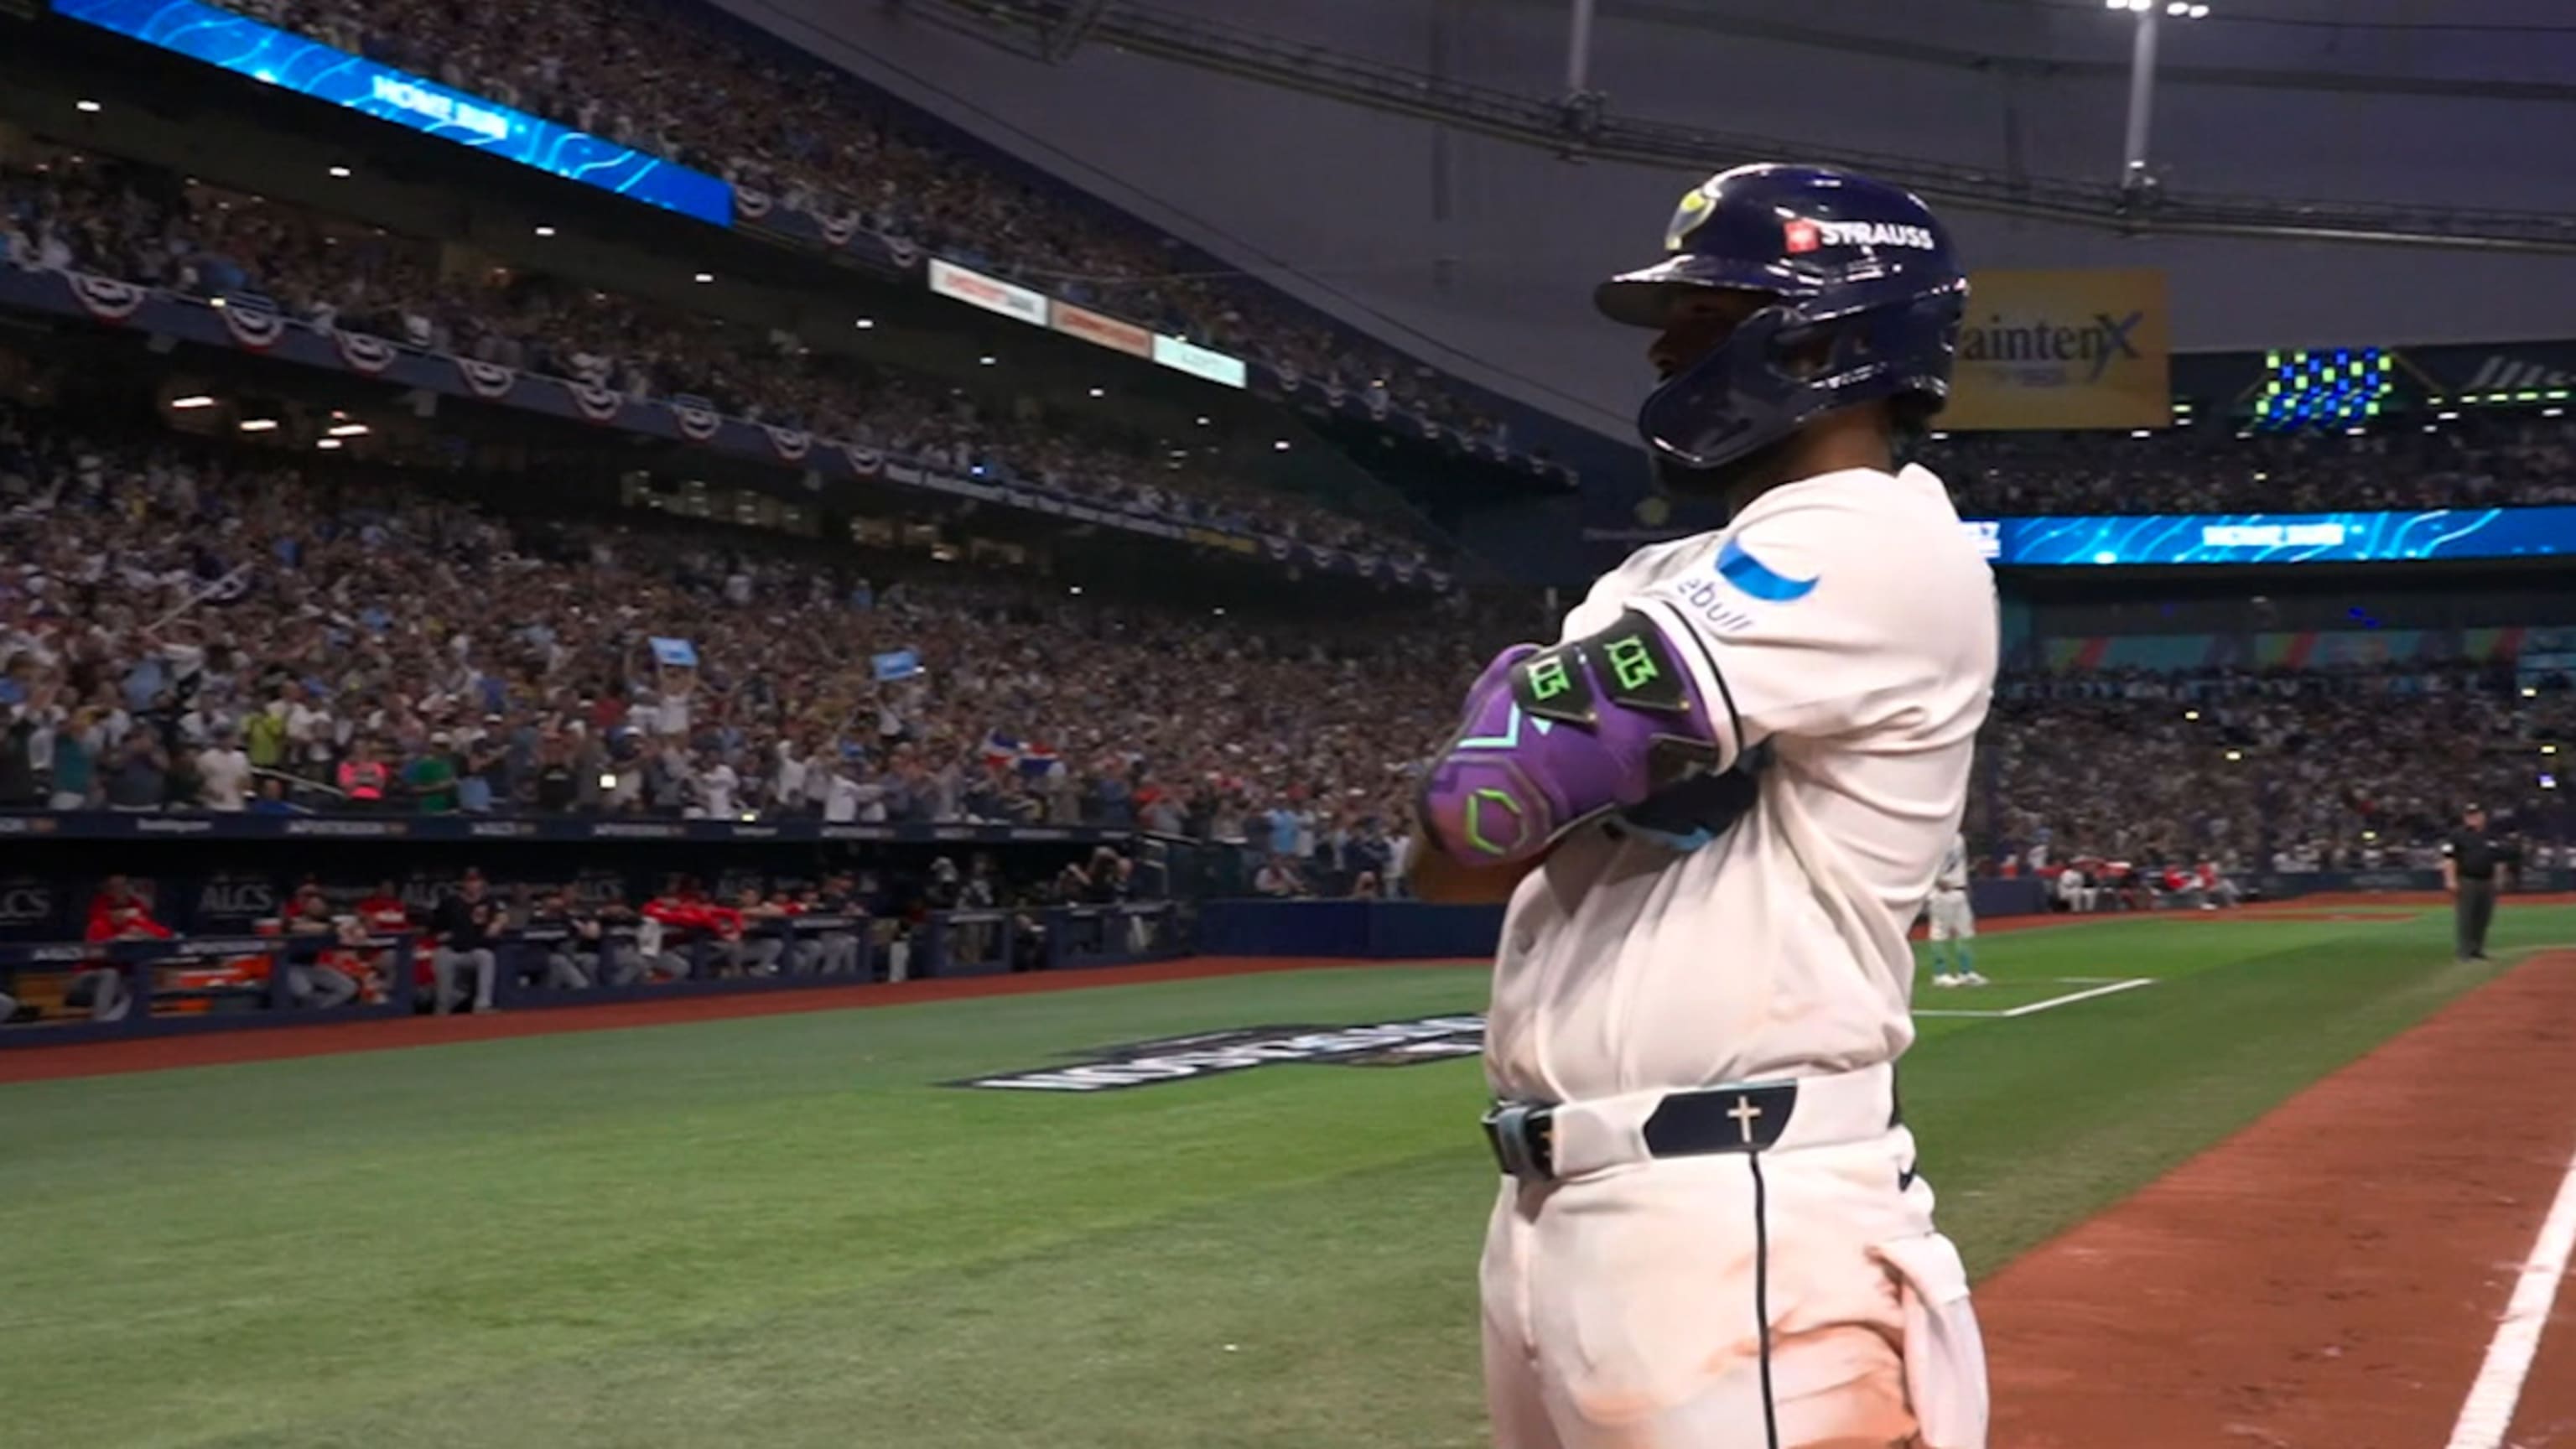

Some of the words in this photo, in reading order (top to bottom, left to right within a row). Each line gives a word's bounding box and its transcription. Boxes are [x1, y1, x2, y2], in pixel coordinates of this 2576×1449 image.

[1820, 221, 1935, 250] STRAUSS
[1961, 310, 2144, 382] aintenX
[1678, 578, 1753, 631] ebull
[198, 883, 273, 912] ALCS
